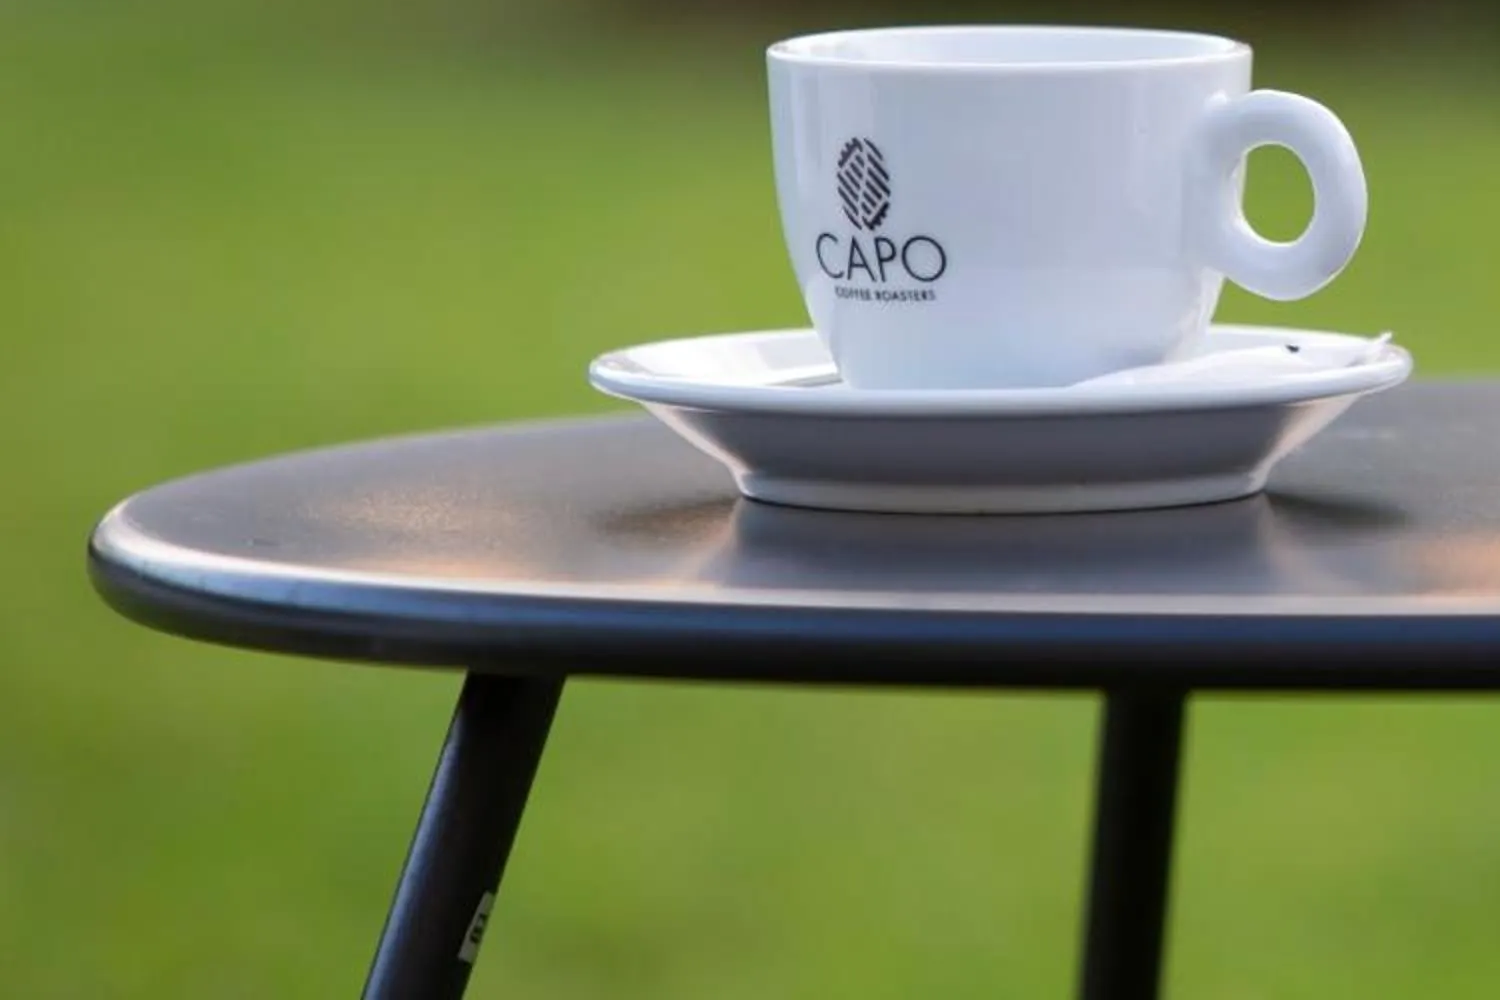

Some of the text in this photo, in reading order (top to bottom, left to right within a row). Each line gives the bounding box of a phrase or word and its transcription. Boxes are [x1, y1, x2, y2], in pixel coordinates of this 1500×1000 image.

[815, 232, 947, 282] CAPO
[834, 285, 936, 301] COFFEE ROASTERS
